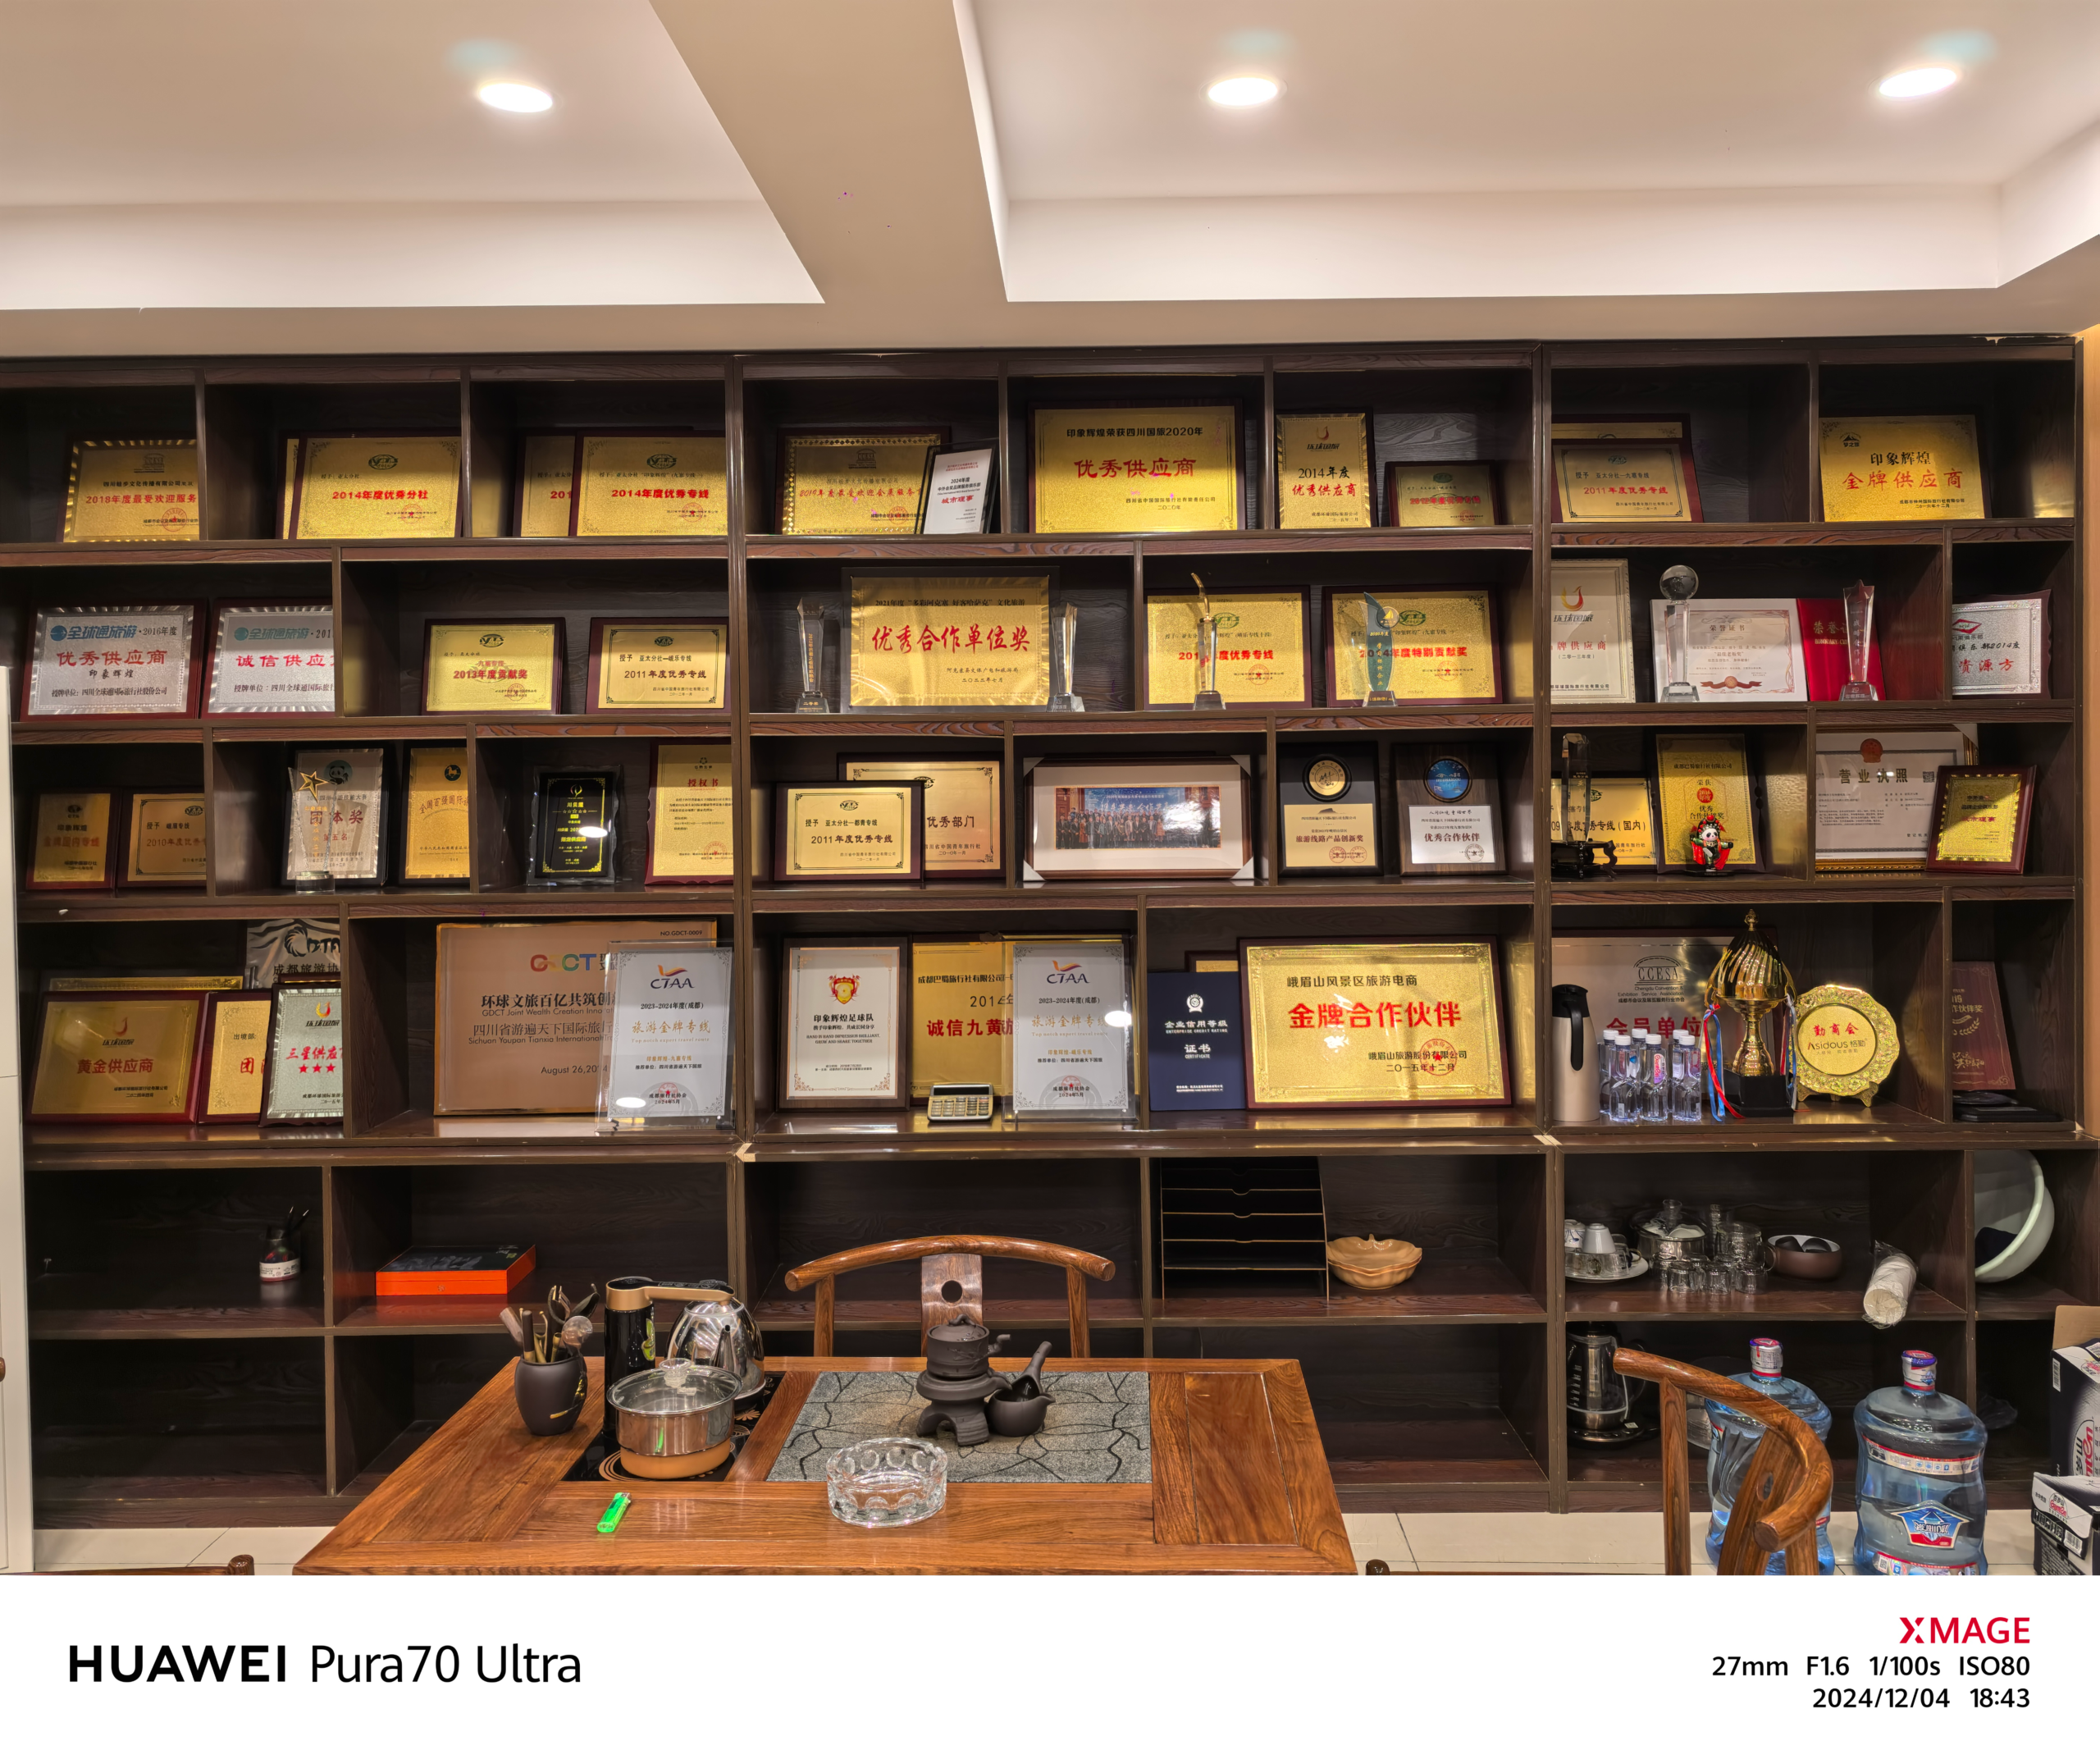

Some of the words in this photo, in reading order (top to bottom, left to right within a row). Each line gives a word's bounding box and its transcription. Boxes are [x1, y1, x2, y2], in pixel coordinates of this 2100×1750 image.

[1066, 427, 1203, 438] 印象辉煌荣获四川国旅2020年
[1870, 451, 1931, 466] 印象辉煌
[1074, 457, 1197, 478] 优秀供应商
[1298, 466, 1350, 479] 2014年度
[1842, 468, 1963, 491] 金牌供应商
[332, 490, 428, 500] 2014年度优秀分社
[612, 489, 709, 499] 2014年度优秀专线
[1292, 482, 1357, 497] 优秀供应商
[67, 625, 138, 640] 全球通旅游
[248, 628, 310, 640] 全球通旅游
[872, 624, 1030, 655] 优秀合作单位奖
[1550, 640, 1606, 651] 牌供应商
[56, 650, 167, 667] 优秀供应商
[619, 654, 632, 662] 授予
[1959, 658, 2015, 674] 资源方
[89, 668, 134, 679] 印象辉煌
[453, 669, 528, 679] 2013年度贡献奖
[625, 669, 707, 679] 2011年度优秀专线
[1839, 768, 1908, 784] 营业执照
[687, 778, 719, 788] 授权书
[147, 822, 159, 830] 授予
[806, 819, 819, 827] 授予
[927, 815, 975, 829] 优秀部门
[810, 834, 893, 844] 2011年度优秀专线
[1296, 834, 1363, 843] 旅游线路产品创新奖
[1424, 833, 1480, 842] 优秀合作伙伴
[660, 929, 704, 937] NO.GDCT-0009
[1638, 966, 1678, 980] CCESA
[650, 978, 696, 989] CTAA
[1047, 973, 1091, 985] CTAA
[1286, 975, 1418, 988] 峨眉山风景区旅游电商
[481, 992, 615, 1008] 环球文旅百亿共筑创
[507, 1008, 523, 1017] Joint
[525, 1008, 551, 1016] Wealth
[553, 1007, 585, 1016] Creation
[814, 1013, 874, 1022] 印象辉煌足球队
[1288, 1001, 1462, 1029] 金牌合作伙伴
[632, 1019, 710, 1035] 旅游金牌专线
[1032, 1015, 1108, 1029] 旅游金牌专线
[1165, 1020, 1228, 1029] 企业信用等级
[1813, 1022, 1859, 1037] 勤商会
[499, 1037, 527, 1046] Youpan
[556, 1035, 601, 1044] International
[1185, 1044, 1211, 1053] 证书
[1368, 1050, 1468, 1061] 峨眉山旅游股份有限公司
[77, 1058, 154, 1075] 黄金供应商
[541, 1065, 569, 1075] August
